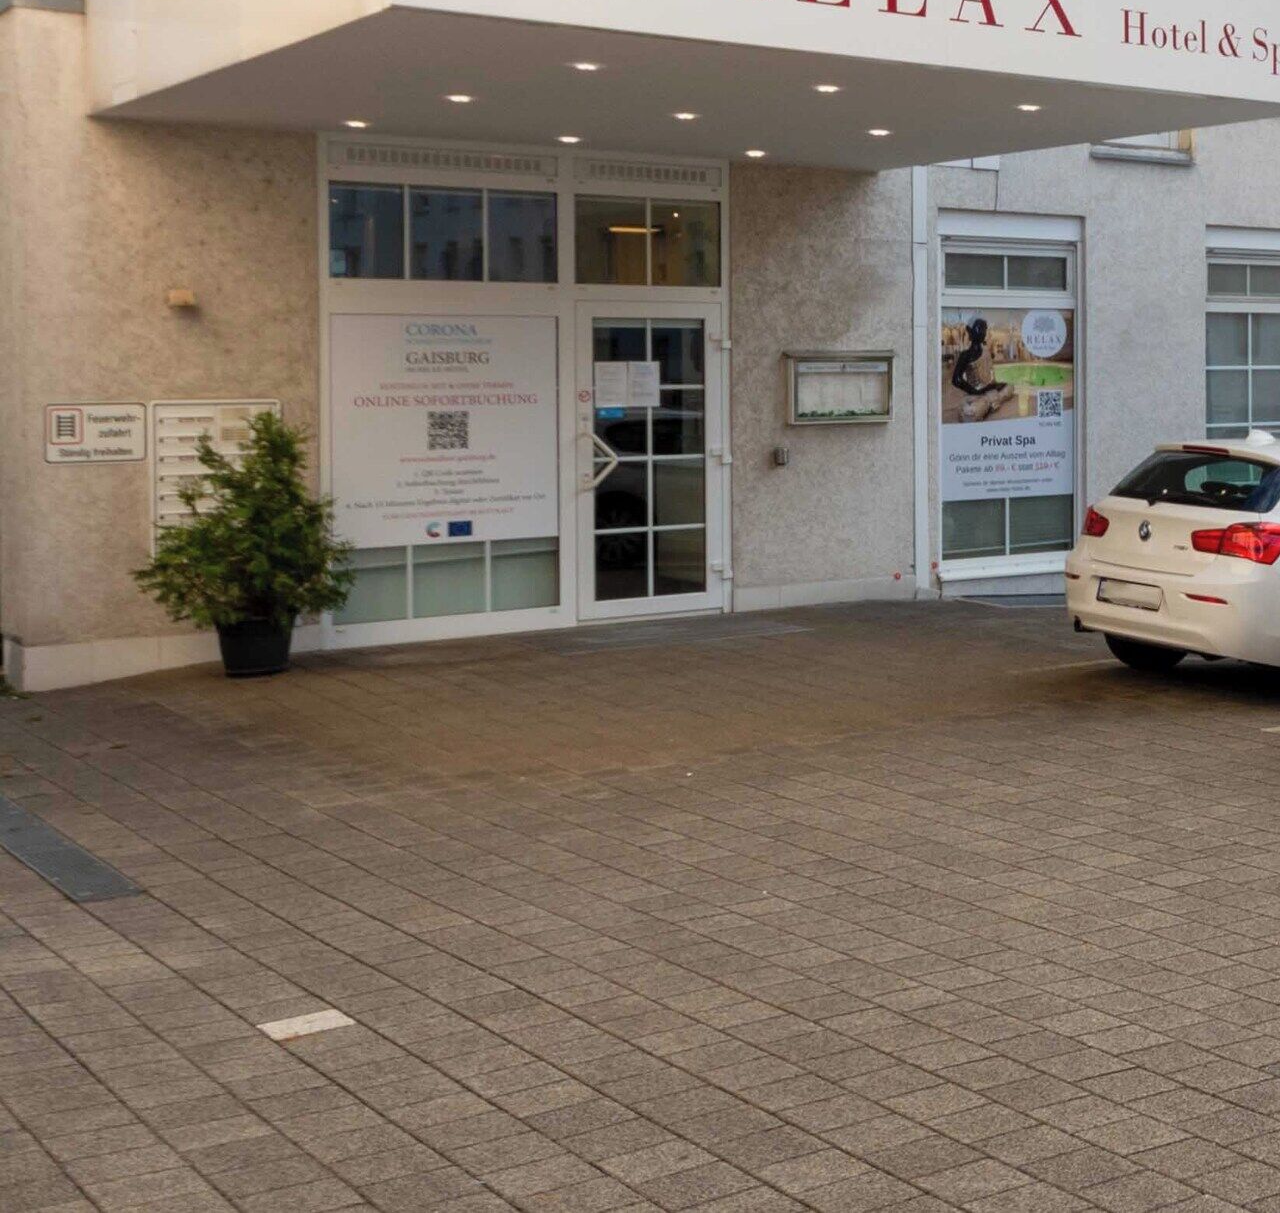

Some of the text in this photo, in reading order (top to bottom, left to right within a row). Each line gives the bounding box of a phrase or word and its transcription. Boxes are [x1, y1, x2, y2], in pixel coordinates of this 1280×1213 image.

[1121, 9, 1210, 54] Hotel
[1217, 24, 1242, 59] &
[405, 324, 478, 337] CORONA
[405, 352, 490, 365] GAISBURG
[353, 392, 539, 408] ONLINE SOFORTBUCHUNG
[981, 435, 1037, 448] Privat Spa
